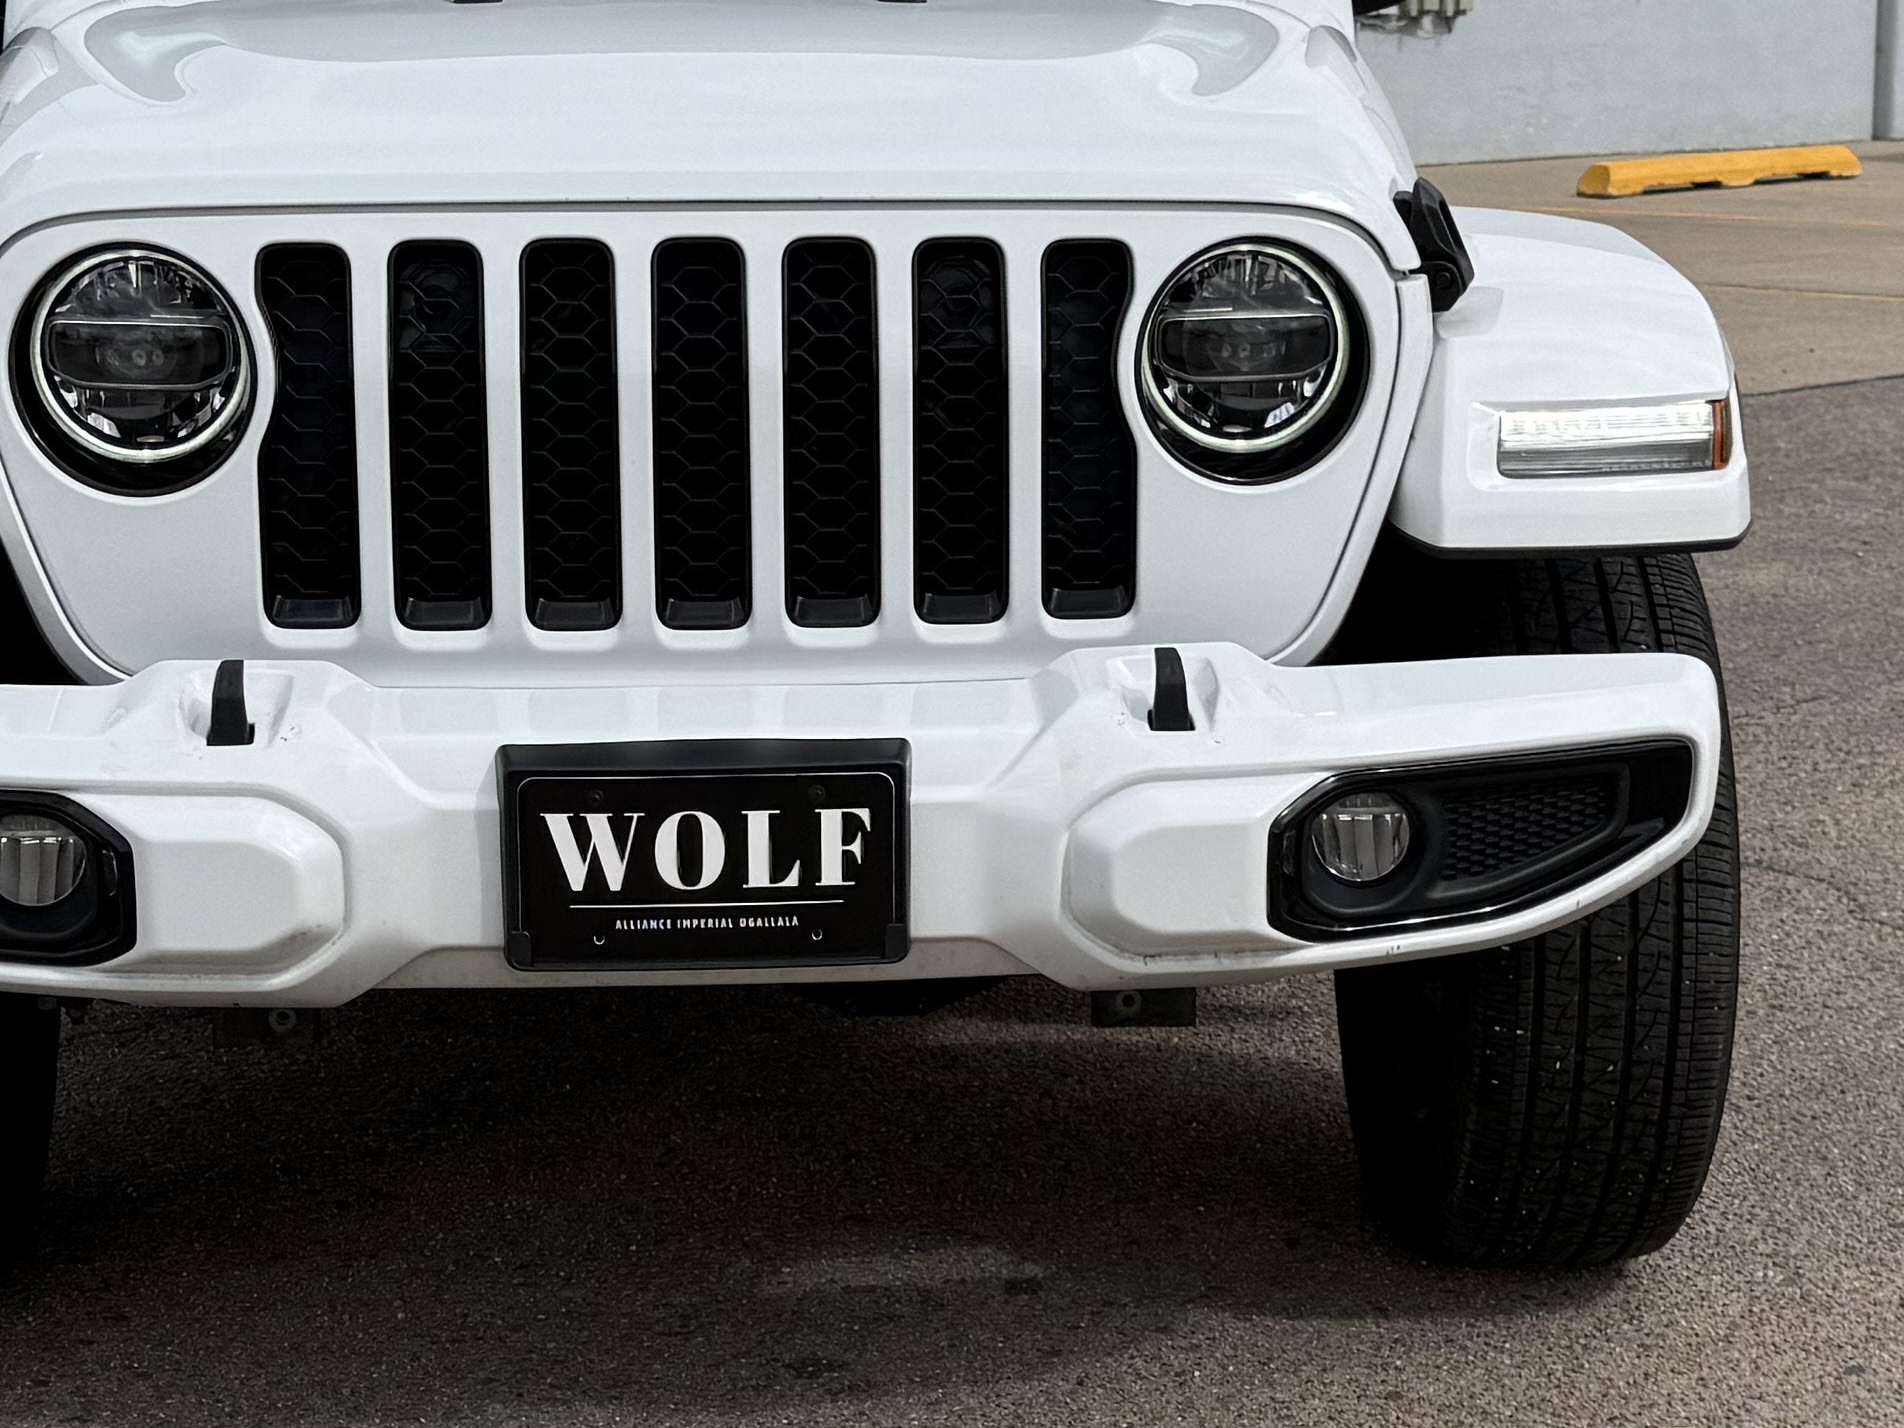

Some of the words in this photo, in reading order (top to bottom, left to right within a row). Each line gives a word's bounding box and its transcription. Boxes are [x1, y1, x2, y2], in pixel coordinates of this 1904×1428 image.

[539, 807, 871, 892] WOLF
[615, 918, 672, 931] ALLIANCE
[676, 917, 734, 929] IMPERIAL
[739, 915, 800, 928] OGALLALA
